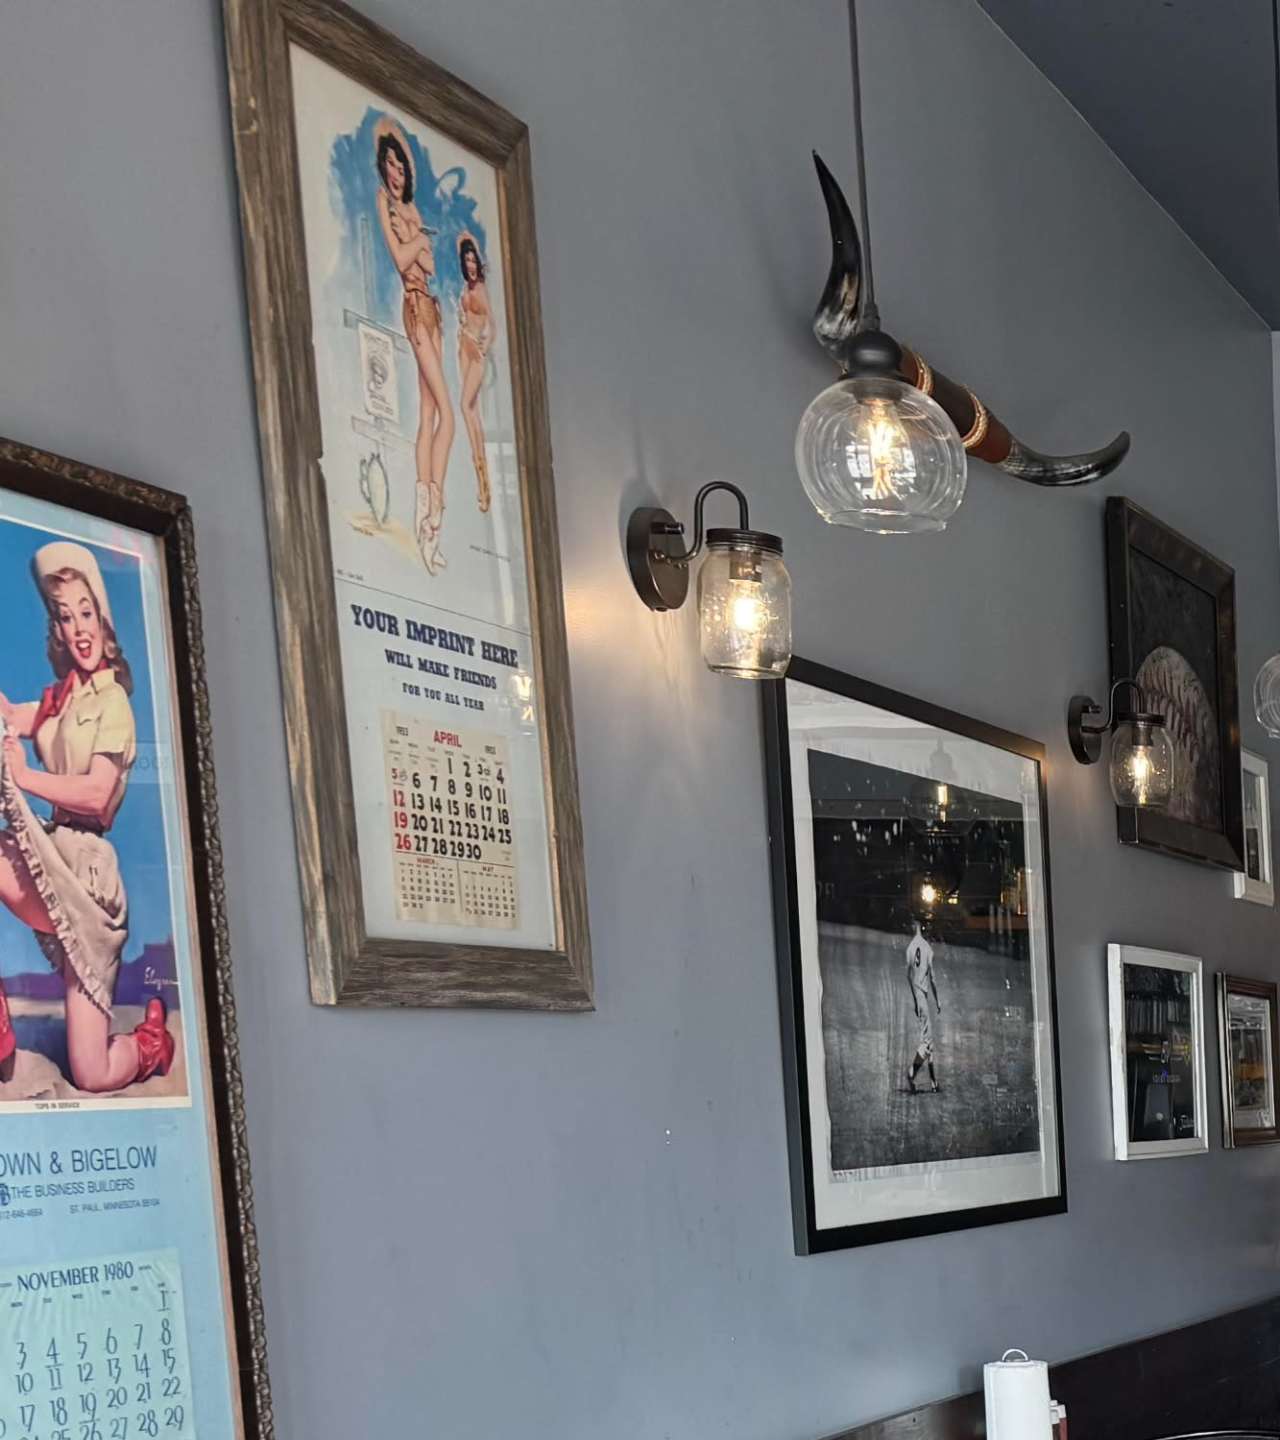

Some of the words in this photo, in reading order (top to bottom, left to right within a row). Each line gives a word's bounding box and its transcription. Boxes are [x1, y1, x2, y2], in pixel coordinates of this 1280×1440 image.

[350, 604, 400, 636] YOUR
[405, 619, 475, 656] IMPRINT
[480, 640, 518, 668] HERE
[384, 649, 414, 668] WILL
[418, 658, 450, 677] MAKE
[453, 667, 497, 690] FRIENDS
[402, 682, 420, 696] FOR
[424, 687, 441, 700] YOU
[444, 692, 460, 706] ALL
[464, 696, 484, 711] YEAR
[433, 730, 462, 748] APRIL
[448, 758, 452, 774] 1
[463, 761, 471, 778] 2
[477, 764, 483, 775] 3
[496, 768, 504, 784] 4
[412, 772, 420, 789] 6
[430, 775, 438, 792] 7
[448, 779, 456, 795] 8
[465, 782, 473, 797] 9
[479, 784, 492, 801] 10
[497, 788, 506, 804] 11
[393, 789, 405, 807] 12
[412, 793, 424, 810] 13
[430, 796, 442, 813] 14
[448, 799, 459, 815] 15
[465, 802, 476, 818] 16
[481, 805, 492, 821] 17
[498, 808, 509, 824] 18
[394, 811, 408, 828] 19
[411, 814, 428, 831] 20
[431, 817, 443, 834] 21
[449, 820, 462, 837] 22
[465, 823, 479, 839] 23
[482, 825, 496, 842] 24
[498, 828, 512, 844] 25
[395, 833, 411, 850] 26
[414, 835, 428, 852] 27
[432, 838, 447, 855] 28
[450, 841, 465, 858] 29
[466, 843, 482, 860] 30
[914, 947, 921, 968] 9
[50, 1151, 64, 1175] &
[71, 1145, 157, 1174] BIGELOW
[11, 1185, 33, 1199] THE
[35, 1182, 85, 1198] BUSINESS
[87, 1178, 135, 1193] BUILDERS
[17, 1265, 99, 1292] NOVEMBER
[104, 1261, 134, 1281] 1980
[17, 1342, 27, 1370] 3
[46, 1337, 60, 1365] 4
[77, 1333, 87, 1360] 5
[106, 1328, 117, 1354] 6
[134, 1324, 143, 1350] 7
[161, 1318, 171, 1345] 8
[16, 1372, 34, 1394] 10
[48, 1368, 61, 1388] 11
[78, 1362, 94, 1382] 12
[107, 1358, 121, 1384] 13
[133, 1353, 150, 1378] 14
[162, 1348, 176, 1374] 15
[20, 1404, 35, 1432] 17
[50, 1397, 68, 1426] 18
[80, 1392, 96, 1420] 19
[106, 1387, 128, 1408] 20
[136, 1382, 151, 1402] 21
[162, 1376, 181, 1397] 22
[137, 1409, 158, 1437] 28
[164, 1405, 184, 1431] 29
